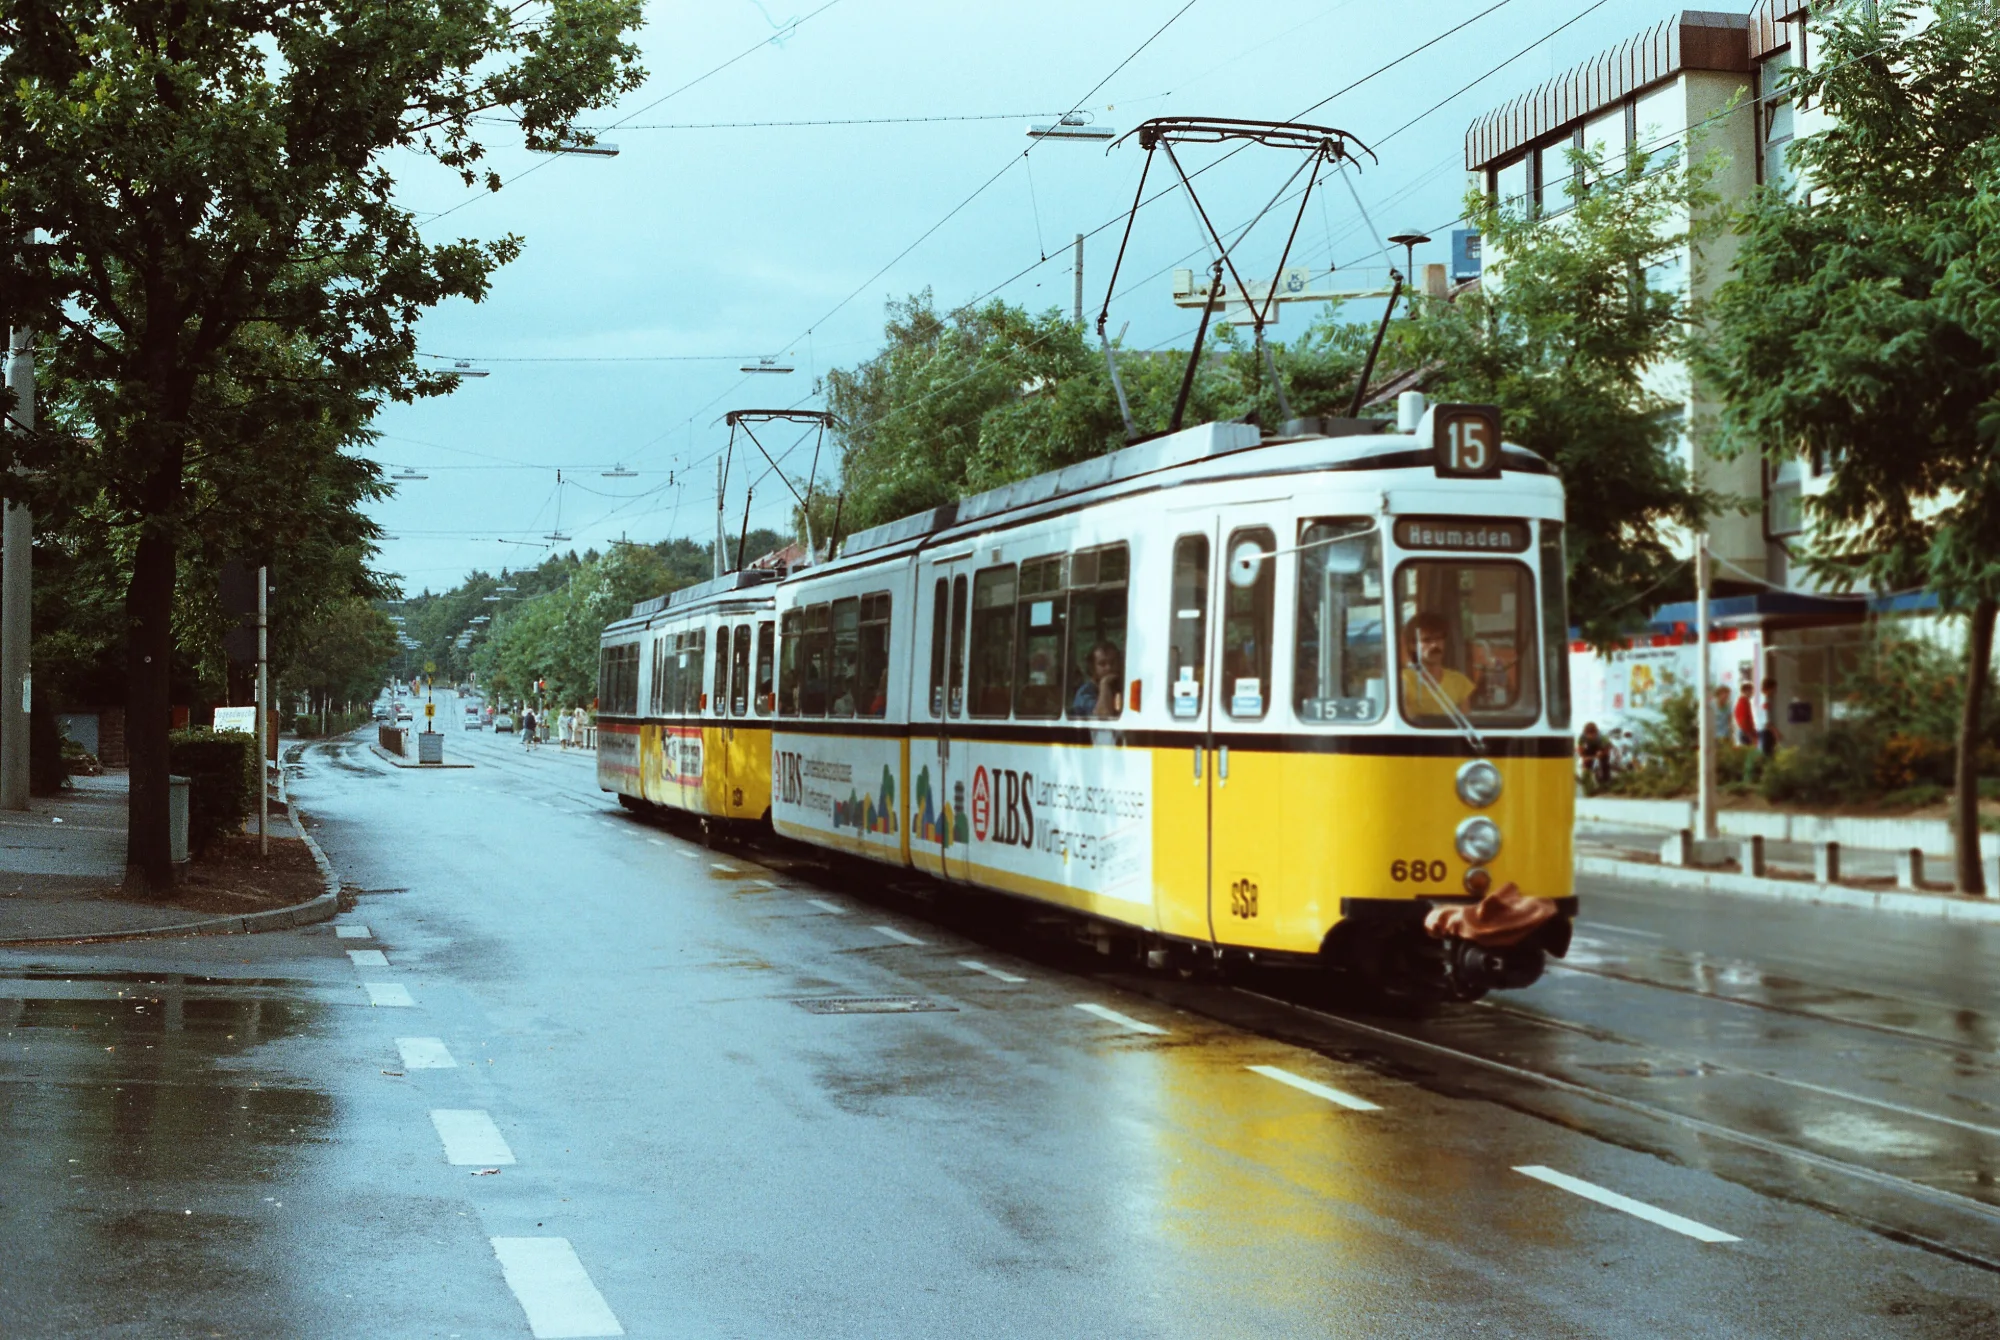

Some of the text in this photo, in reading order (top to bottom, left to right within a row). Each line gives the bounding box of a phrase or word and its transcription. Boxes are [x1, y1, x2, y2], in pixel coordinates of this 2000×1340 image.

[1448, 422, 1486, 469] 15
[1409, 525, 1511, 546] Heumaden
[1314, 700, 1369, 719] 15 3
[782, 752, 802, 806] LBS
[991, 768, 1034, 849] LBS
[1391, 859, 1447, 882] 680
